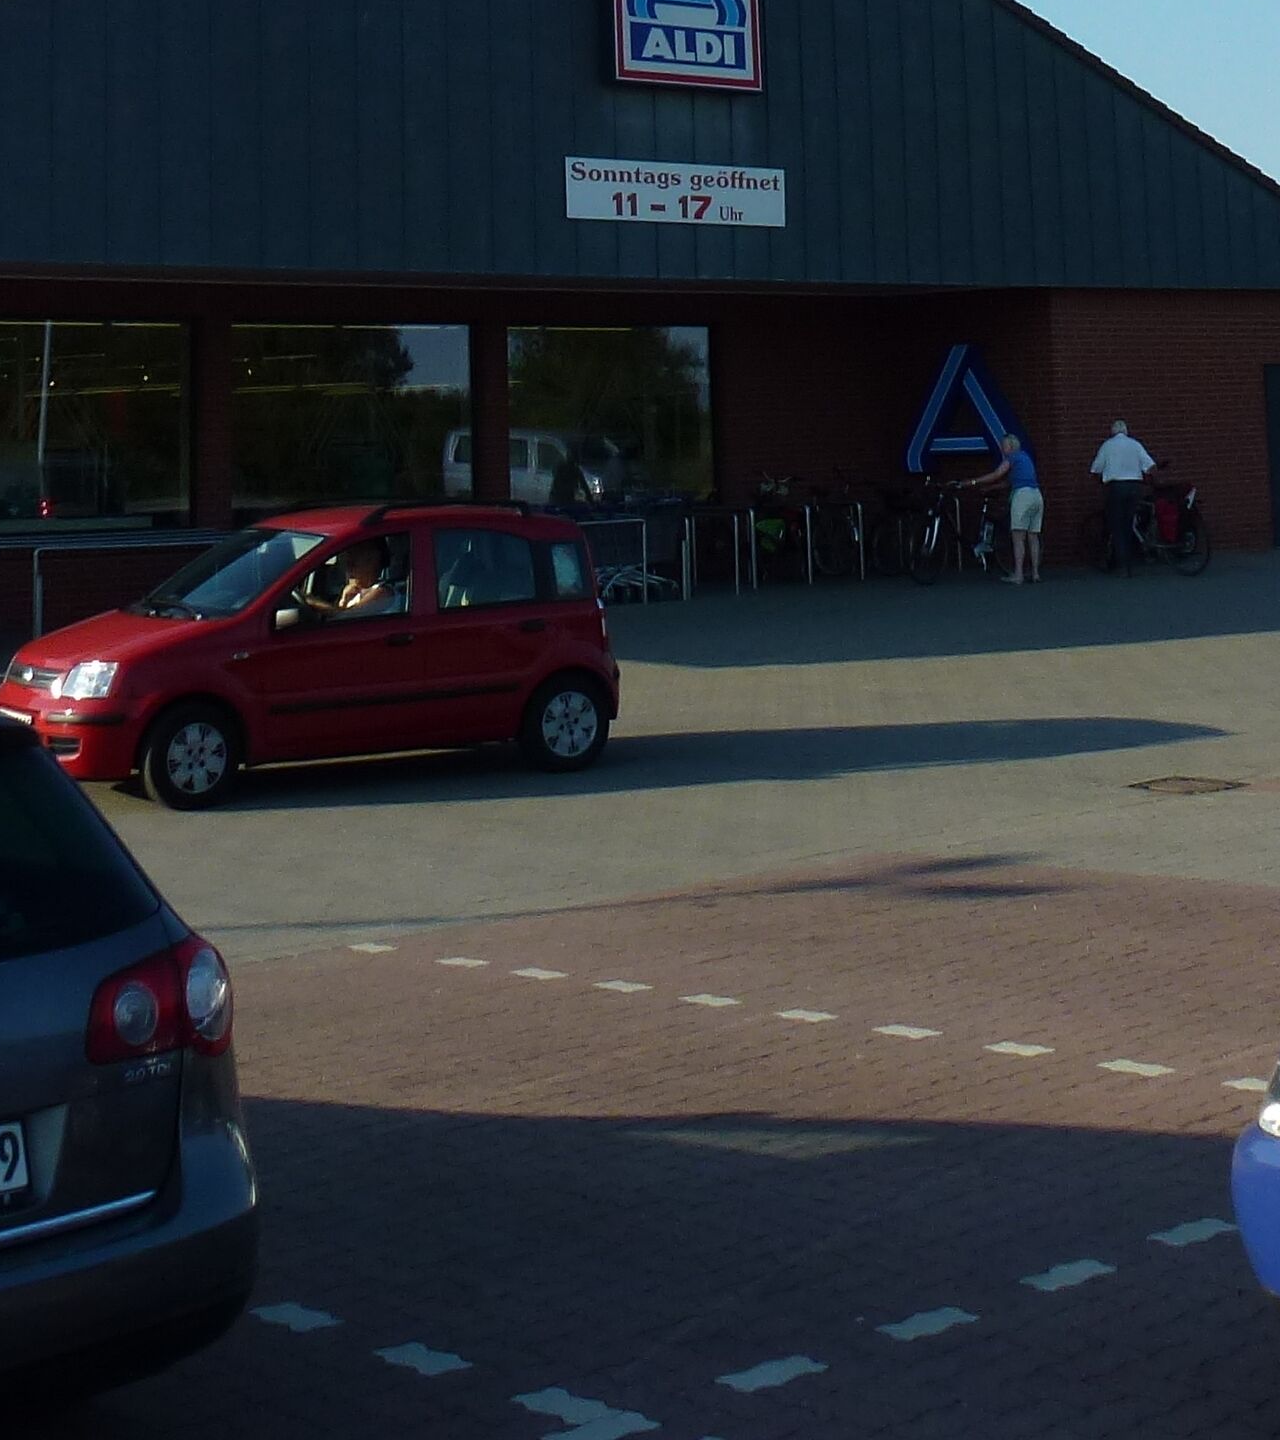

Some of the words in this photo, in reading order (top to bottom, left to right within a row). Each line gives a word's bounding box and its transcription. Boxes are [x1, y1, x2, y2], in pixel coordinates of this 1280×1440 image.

[641, 27, 736, 65] ALDI
[570, 161, 681, 190] Sonntags
[690, 169, 780, 192] geöffnet
[612, 191, 638, 217] 11
[678, 195, 712, 220] 17
[719, 206, 744, 222] Uhr
